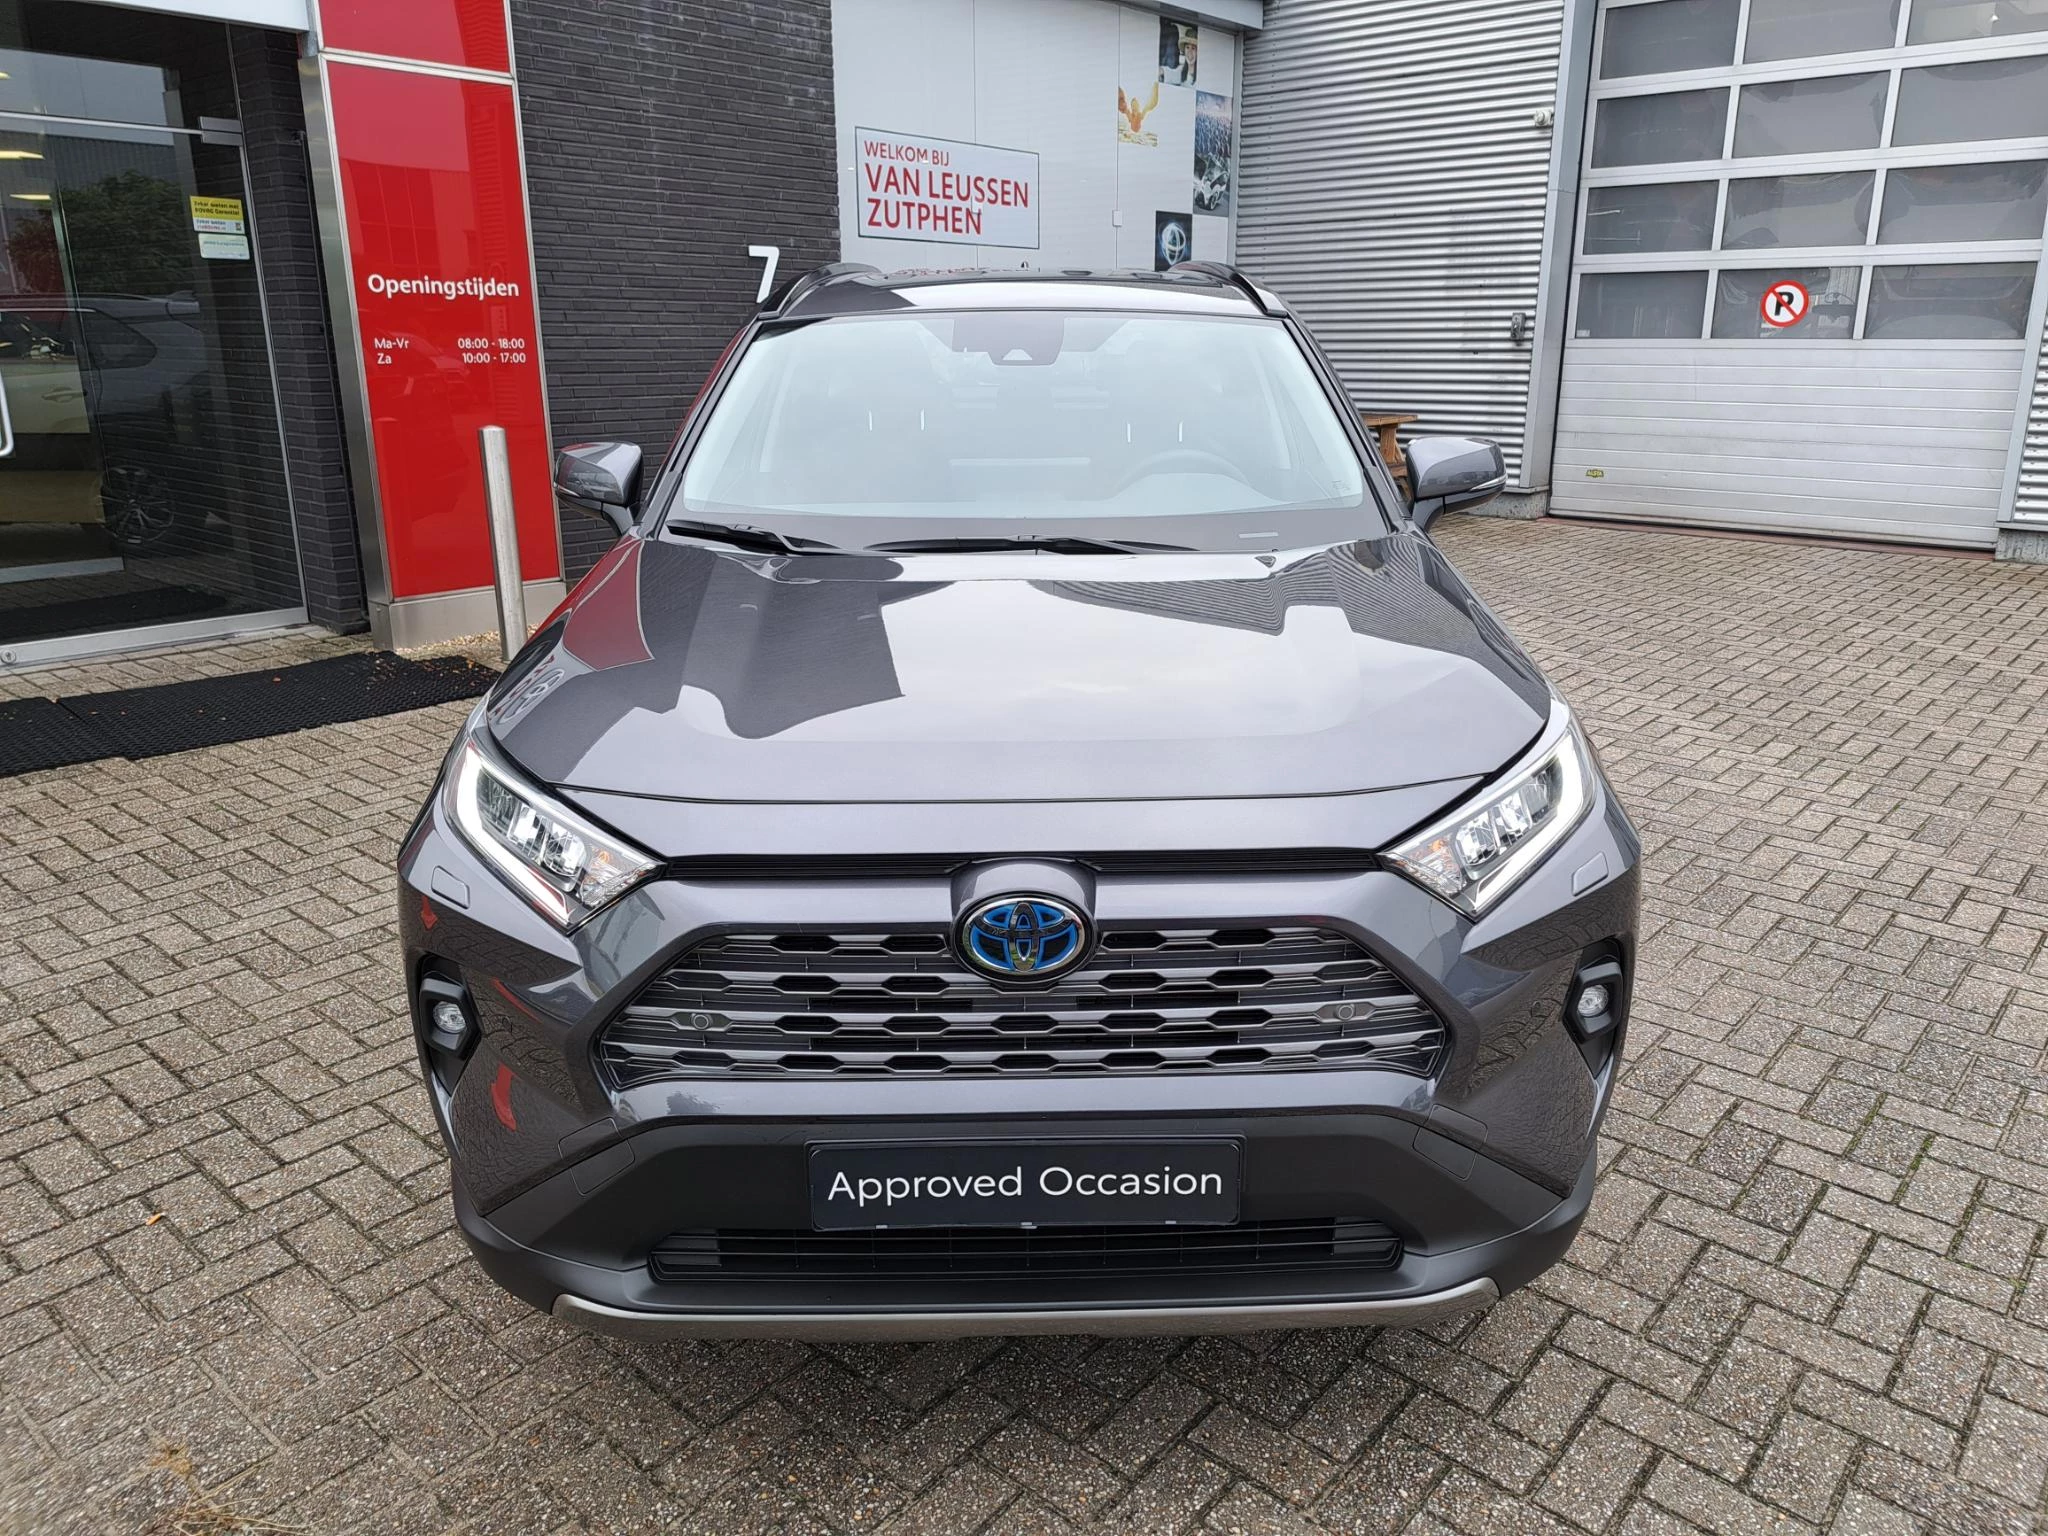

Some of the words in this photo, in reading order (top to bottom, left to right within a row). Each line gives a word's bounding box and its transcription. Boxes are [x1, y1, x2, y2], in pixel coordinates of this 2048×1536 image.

[863, 140, 928, 163] WELKOM
[932, 150, 950, 167] BIJ
[865, 163, 920, 197] VAN
[928, 170, 1029, 208] LEUSSEN
[867, 197, 982, 235] ZUTPHEN
[367, 273, 520, 301] Openingstijden
[748, 244, 780, 303] 7
[1774, 291, 1794, 316] P
[374, 337, 409, 349] Ma-Vr
[457, 337, 489, 349] 08:00
[498, 338, 525, 349] 18:00
[377, 353, 392, 365] Za
[462, 352, 490, 363] 10:00
[500, 352, 526, 363] 17:00
[827, 1166, 1023, 1207] Approved
[1039, 1166, 1223, 1197] Occasion
